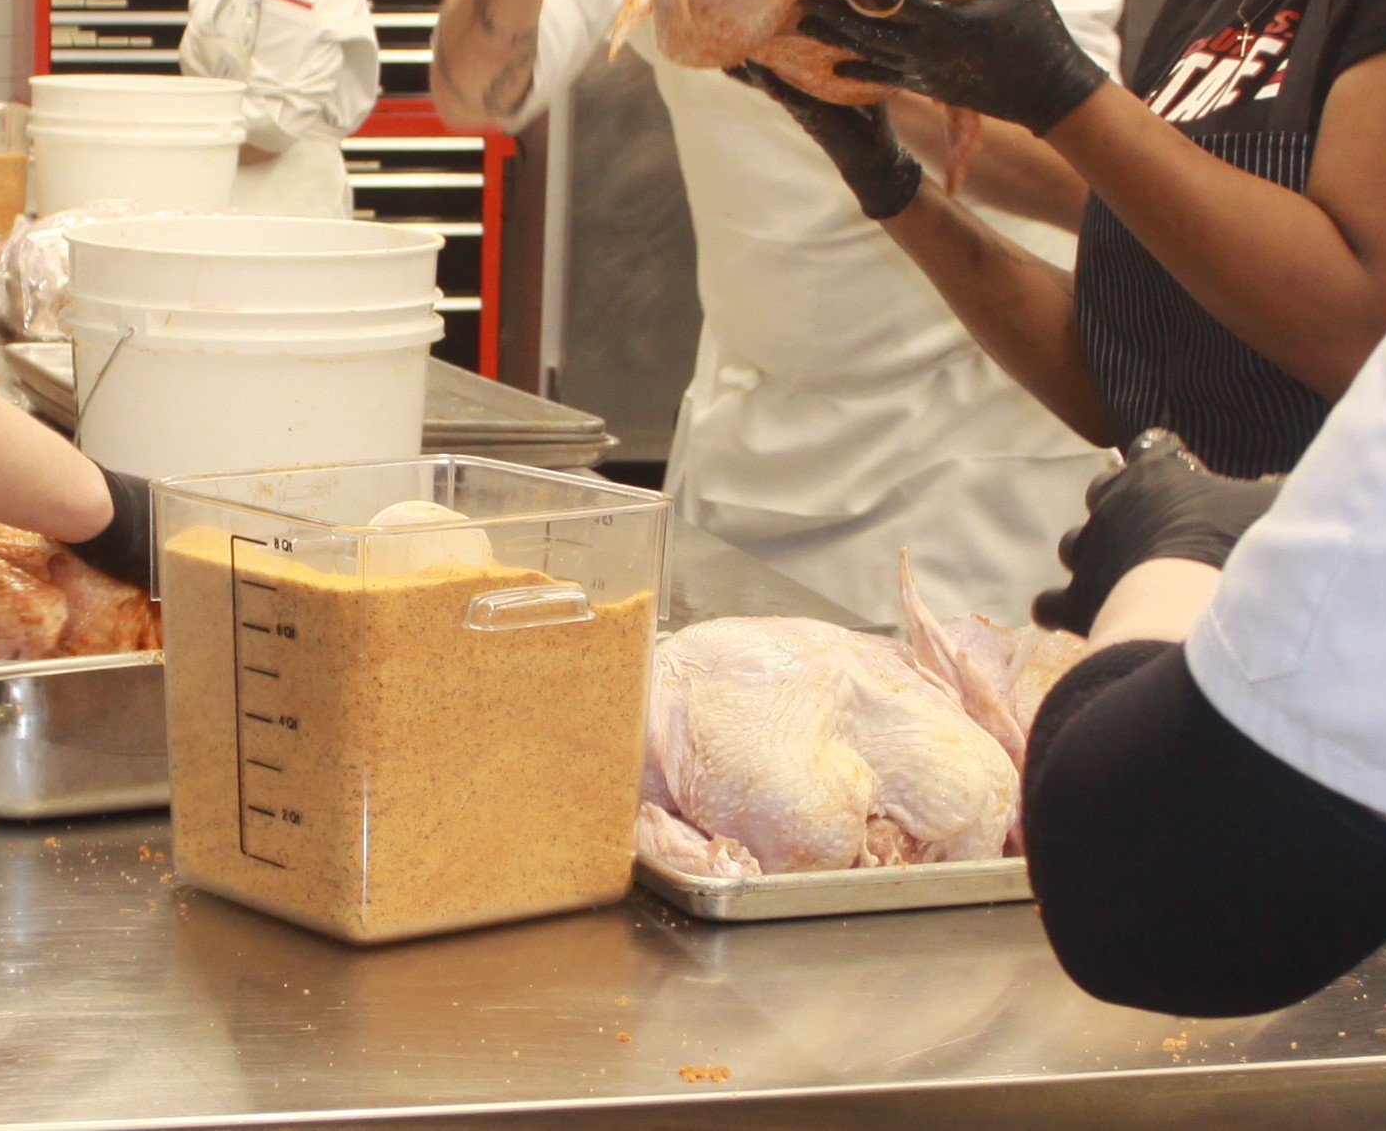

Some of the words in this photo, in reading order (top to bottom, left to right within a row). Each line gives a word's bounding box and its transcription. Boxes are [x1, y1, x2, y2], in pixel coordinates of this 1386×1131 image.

[274, 537, 279, 549] 8
[282, 539, 293, 553] Qt
[284, 626, 295, 639] Qt
[286, 716, 297, 730] Qt
[282, 809, 288, 821] 2
[290, 811, 300, 826] Qt
